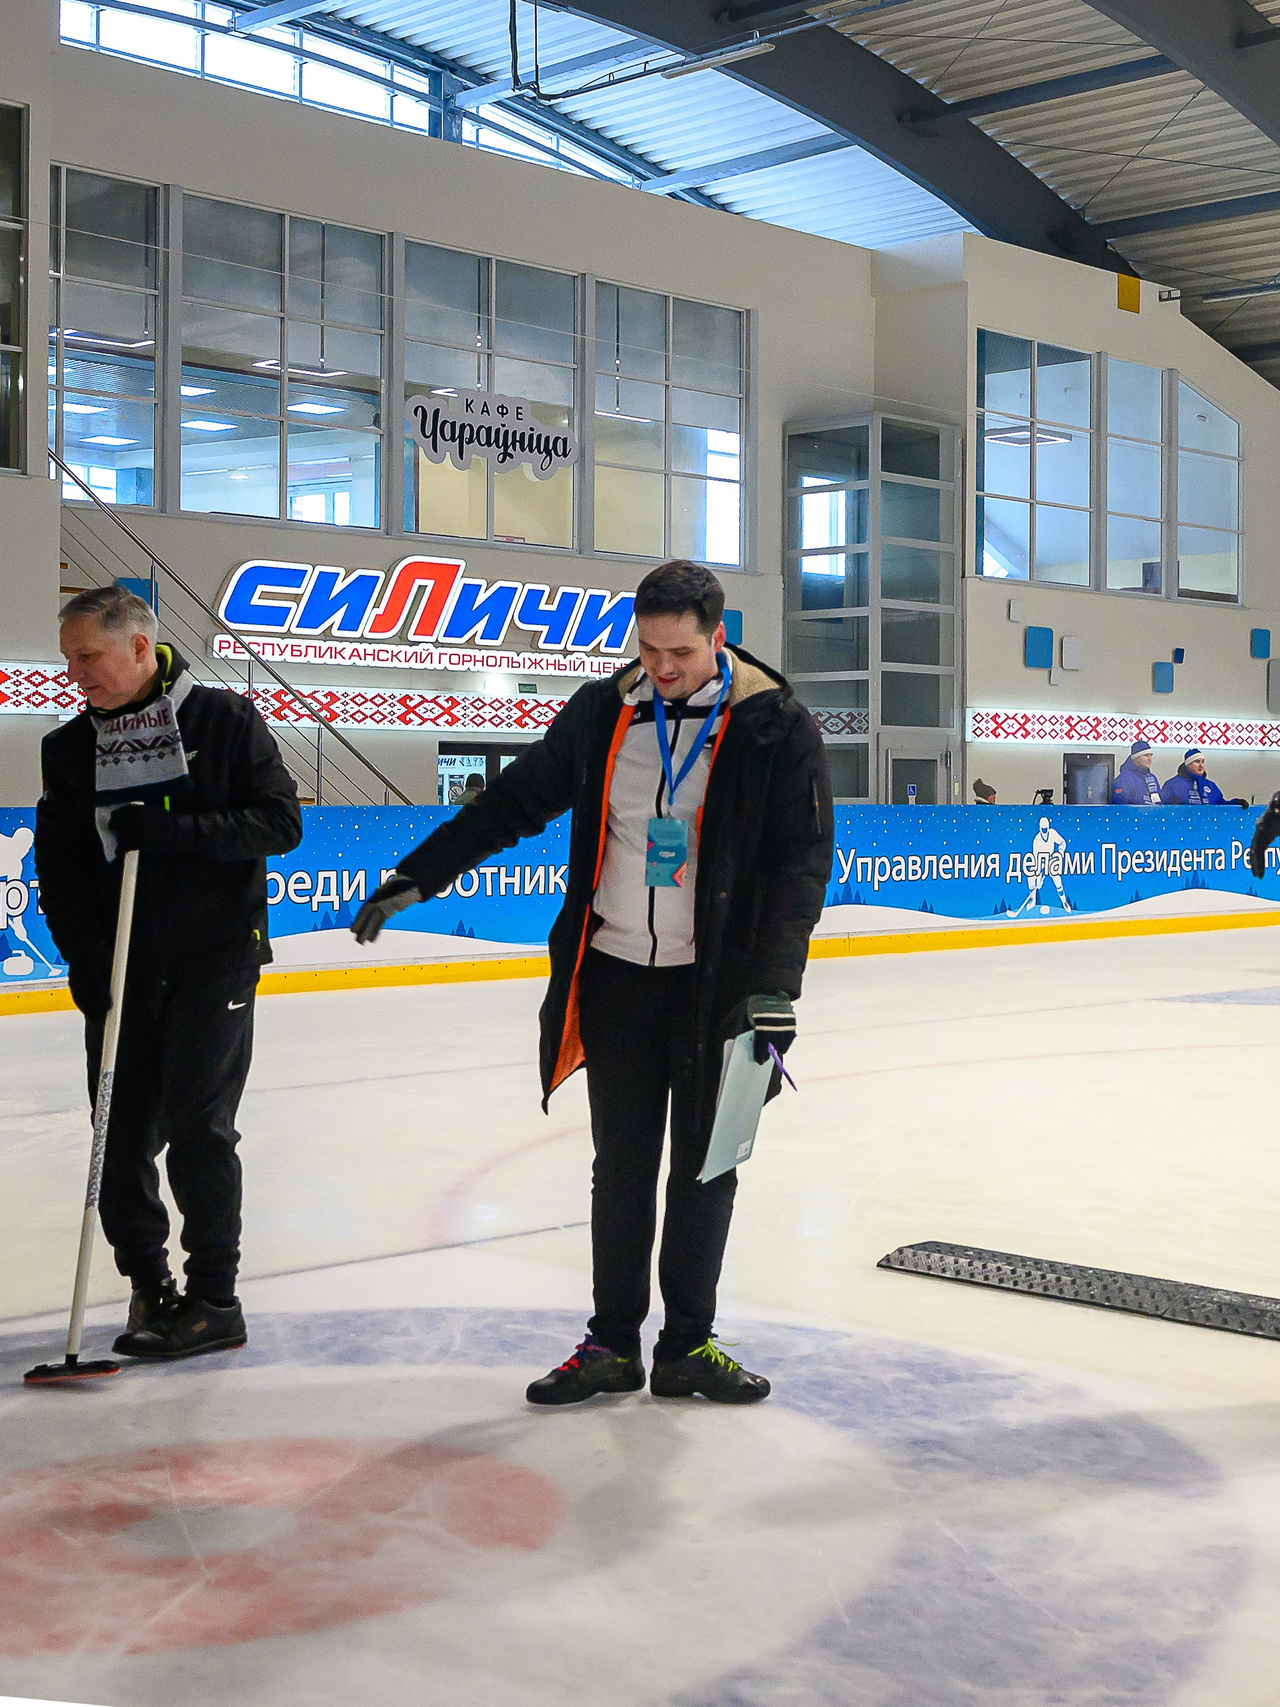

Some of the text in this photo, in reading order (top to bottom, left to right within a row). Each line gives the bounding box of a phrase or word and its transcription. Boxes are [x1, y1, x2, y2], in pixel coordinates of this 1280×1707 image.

[465, 398, 524, 421] КАФЕ
[413, 405, 572, 471] Чараўніца
[218, 639, 434, 665] РЕСПУБЛИКАНСКИЙ
[438, 652, 586, 673] ГОРНОЛЫЖНЫЙ
[836, 848, 1001, 892] Управления
[1005, 850, 1096, 884] делами
[1100, 842, 1226, 882] Президента
